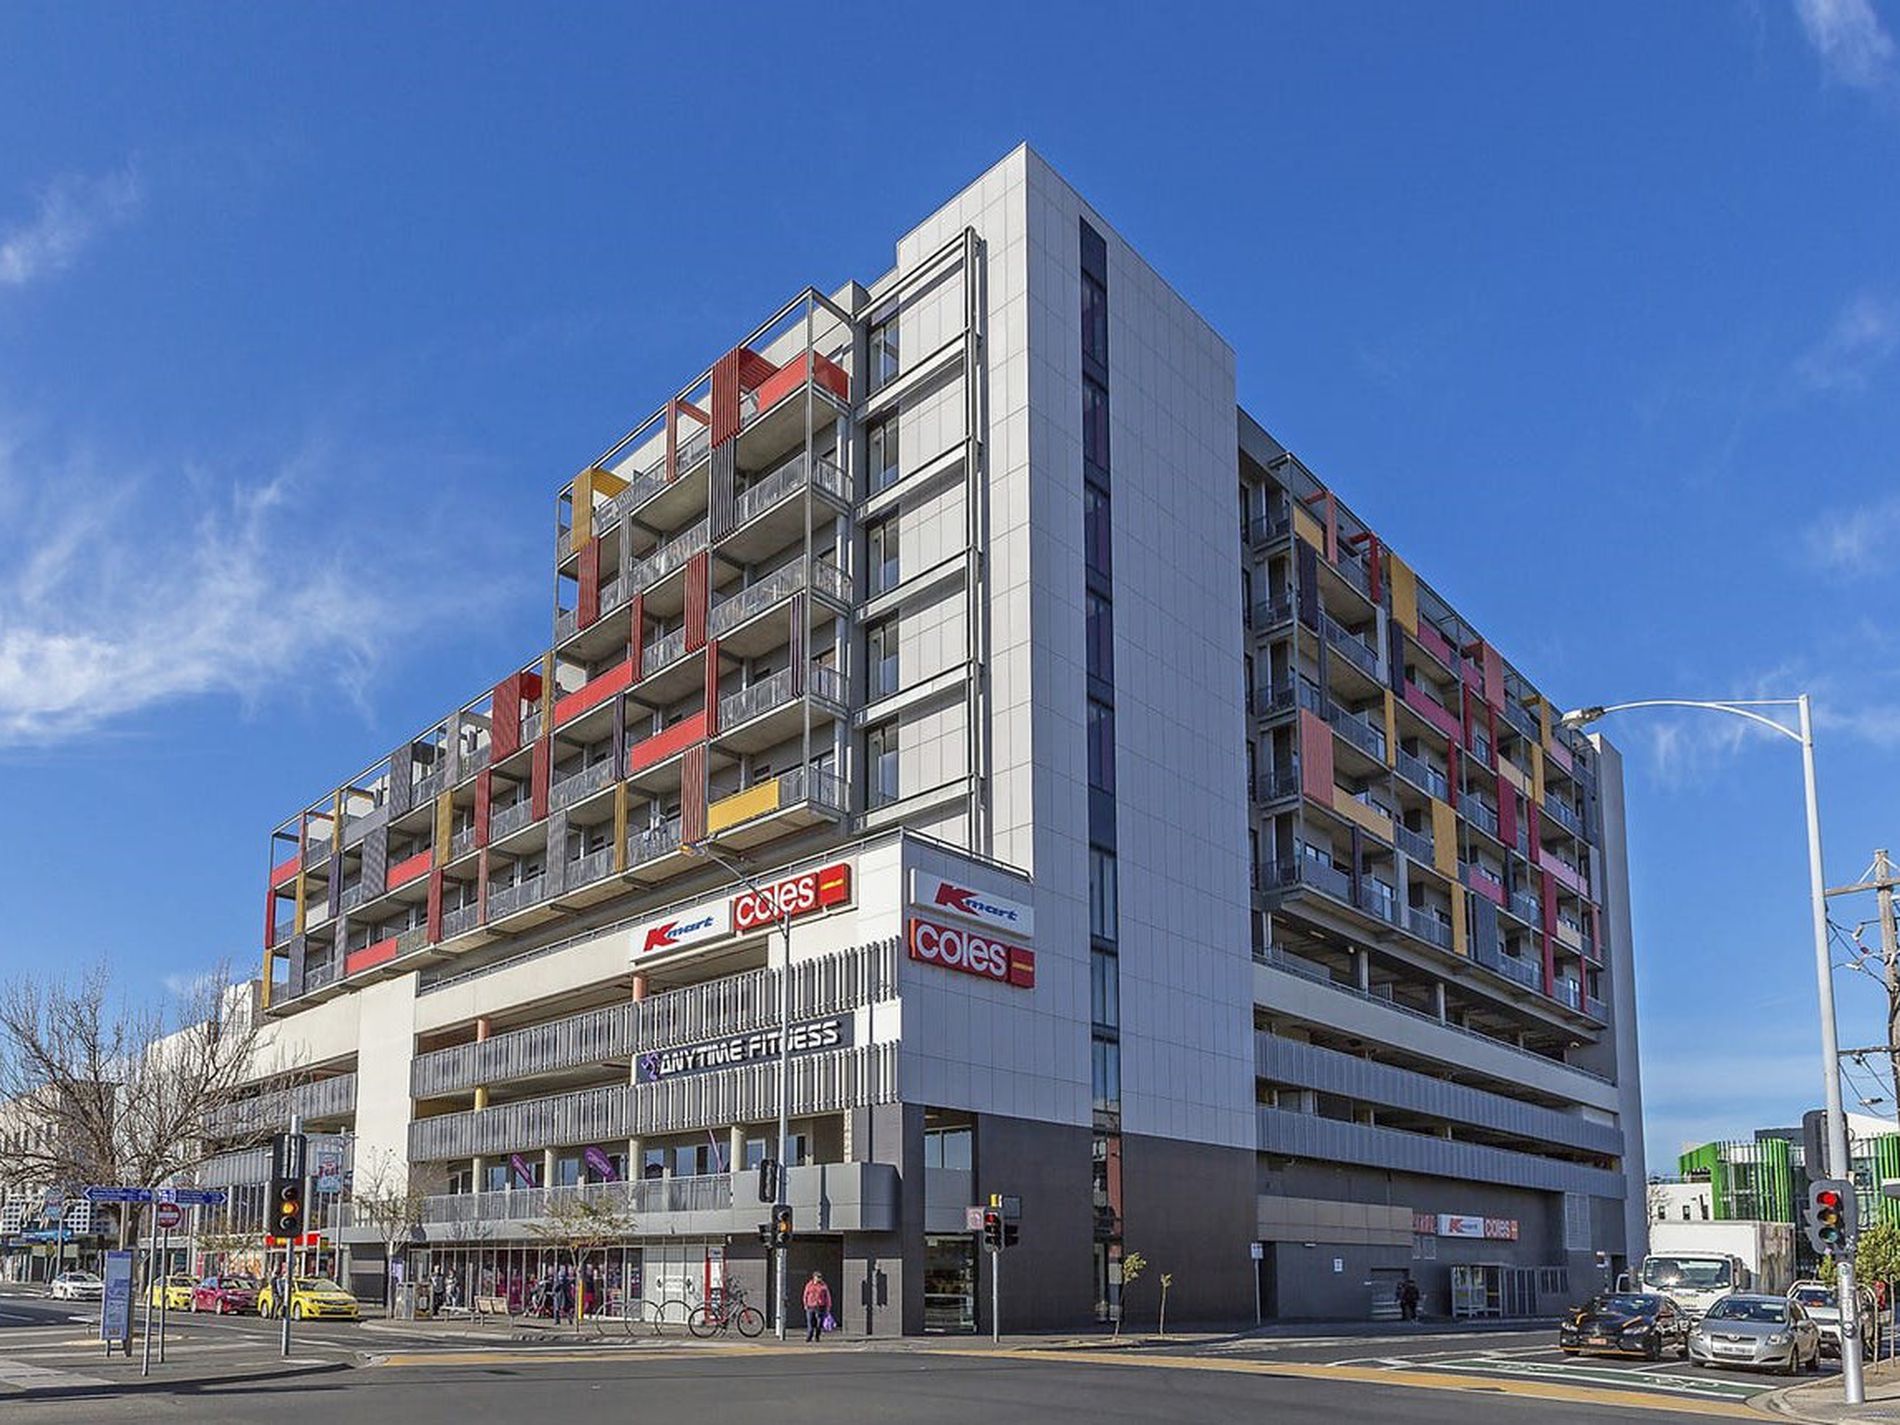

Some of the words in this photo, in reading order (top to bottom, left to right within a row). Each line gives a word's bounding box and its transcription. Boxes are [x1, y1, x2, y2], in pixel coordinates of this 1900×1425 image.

[736, 877, 816, 926] coles
[935, 882, 1018, 921] Kmart
[643, 916, 715, 952] Kmart
[916, 924, 1007, 976] coles
[659, 1039, 743, 1075] ANYTIME
